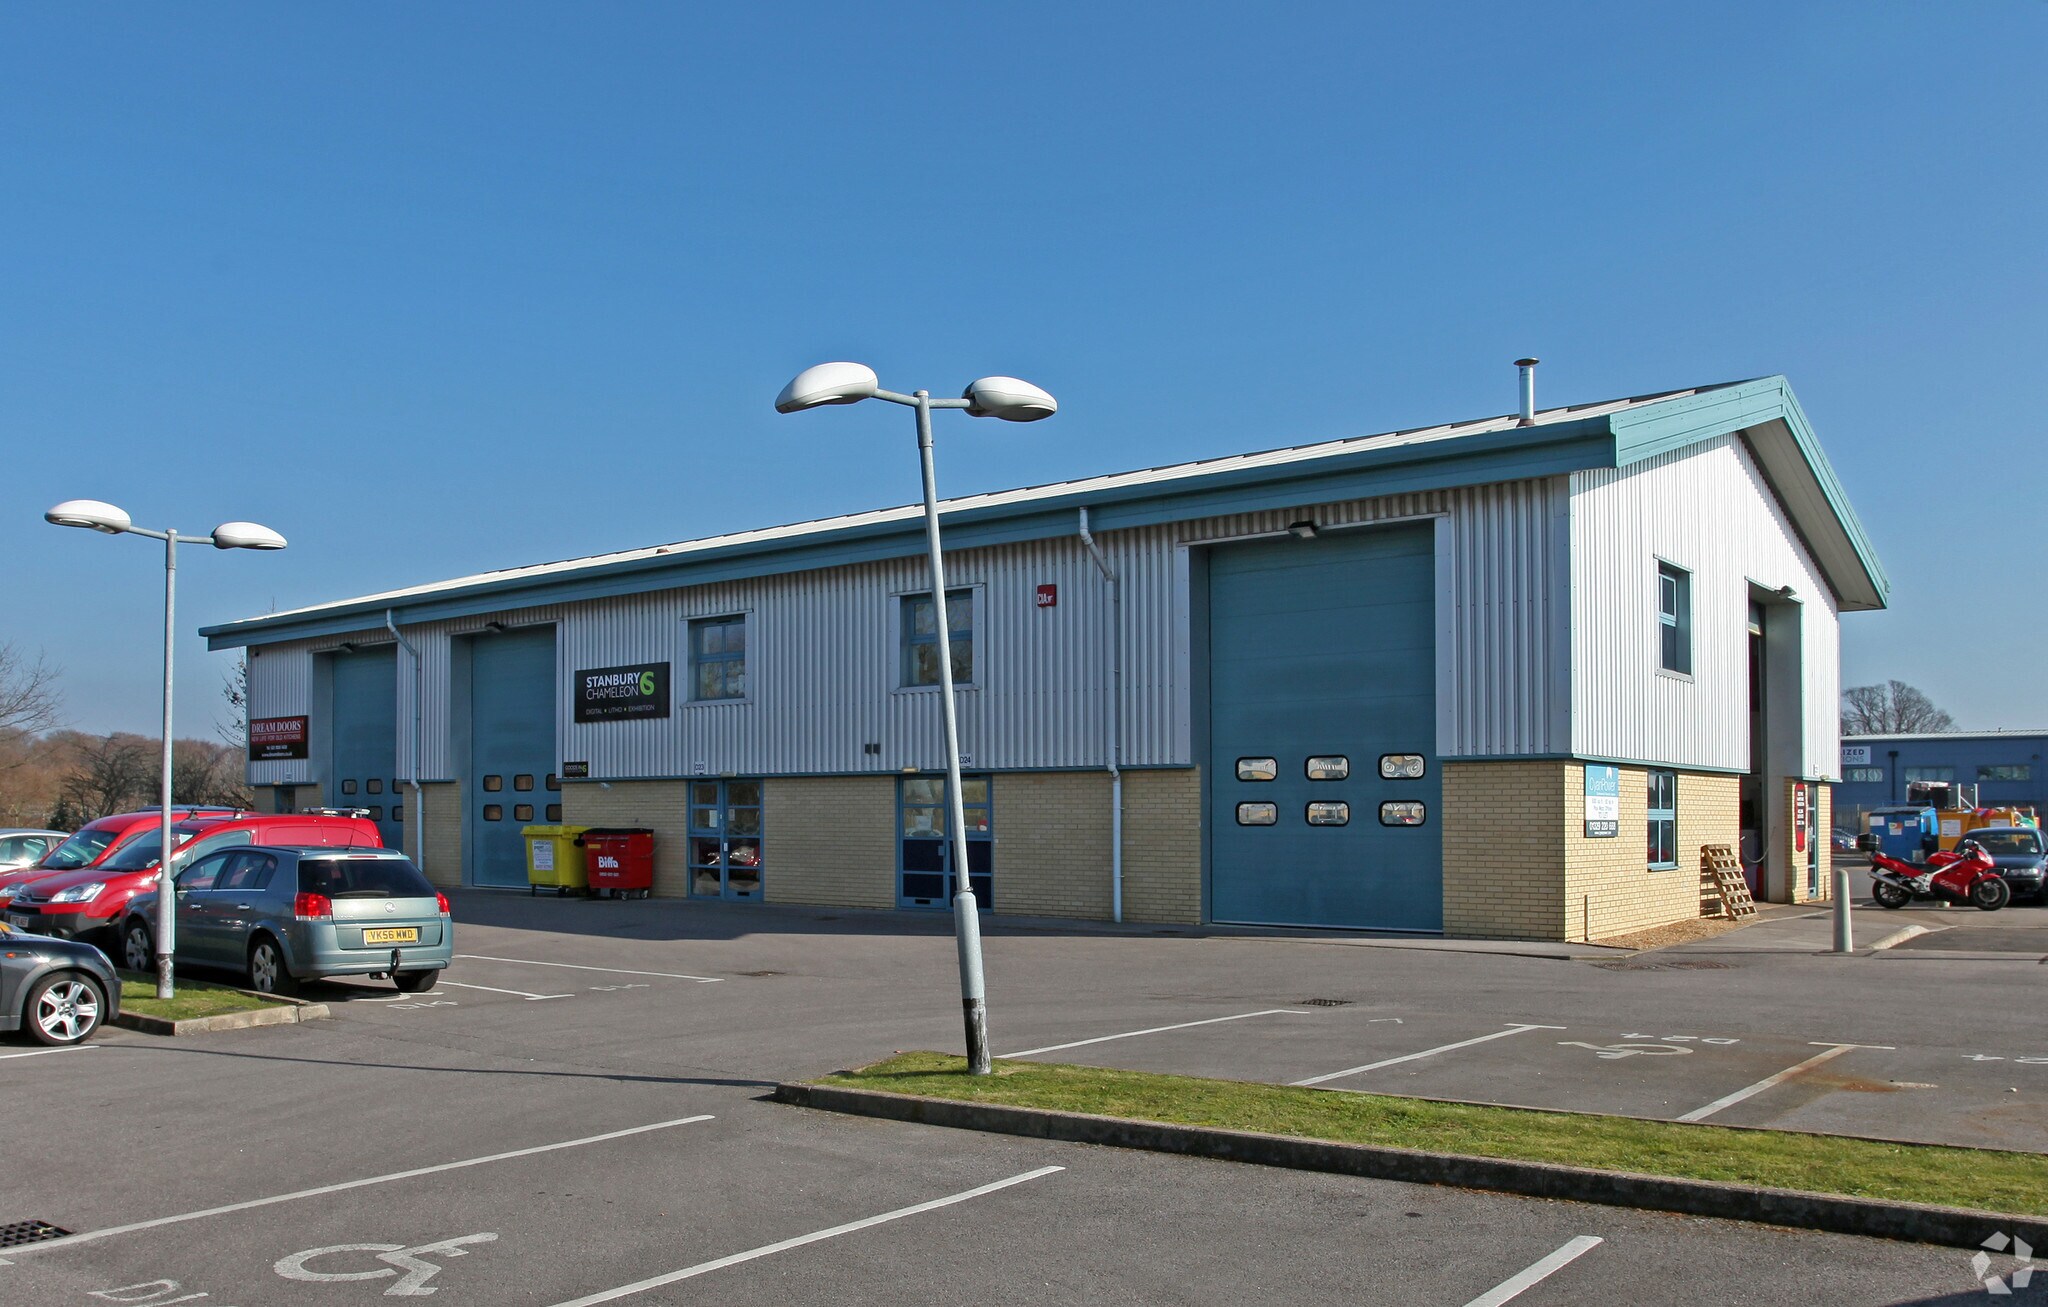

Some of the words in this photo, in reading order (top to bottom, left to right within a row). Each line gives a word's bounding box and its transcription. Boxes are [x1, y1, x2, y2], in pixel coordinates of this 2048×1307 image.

[586, 671, 640, 689] STANBURY
[586, 685, 639, 700] CHAMELEON
[586, 708, 602, 716] DIGITAL
[608, 706, 622, 714] LITHO
[628, 704, 655, 713] EXHIBITION
[252, 723, 275, 733] DREAM
[276, 721, 301, 731] DOORS
[1841, 748, 1865, 756] IZED
[598, 856, 619, 868] Biffa
[370, 930, 395, 940] VK56
[396, 929, 413, 939] MWD
